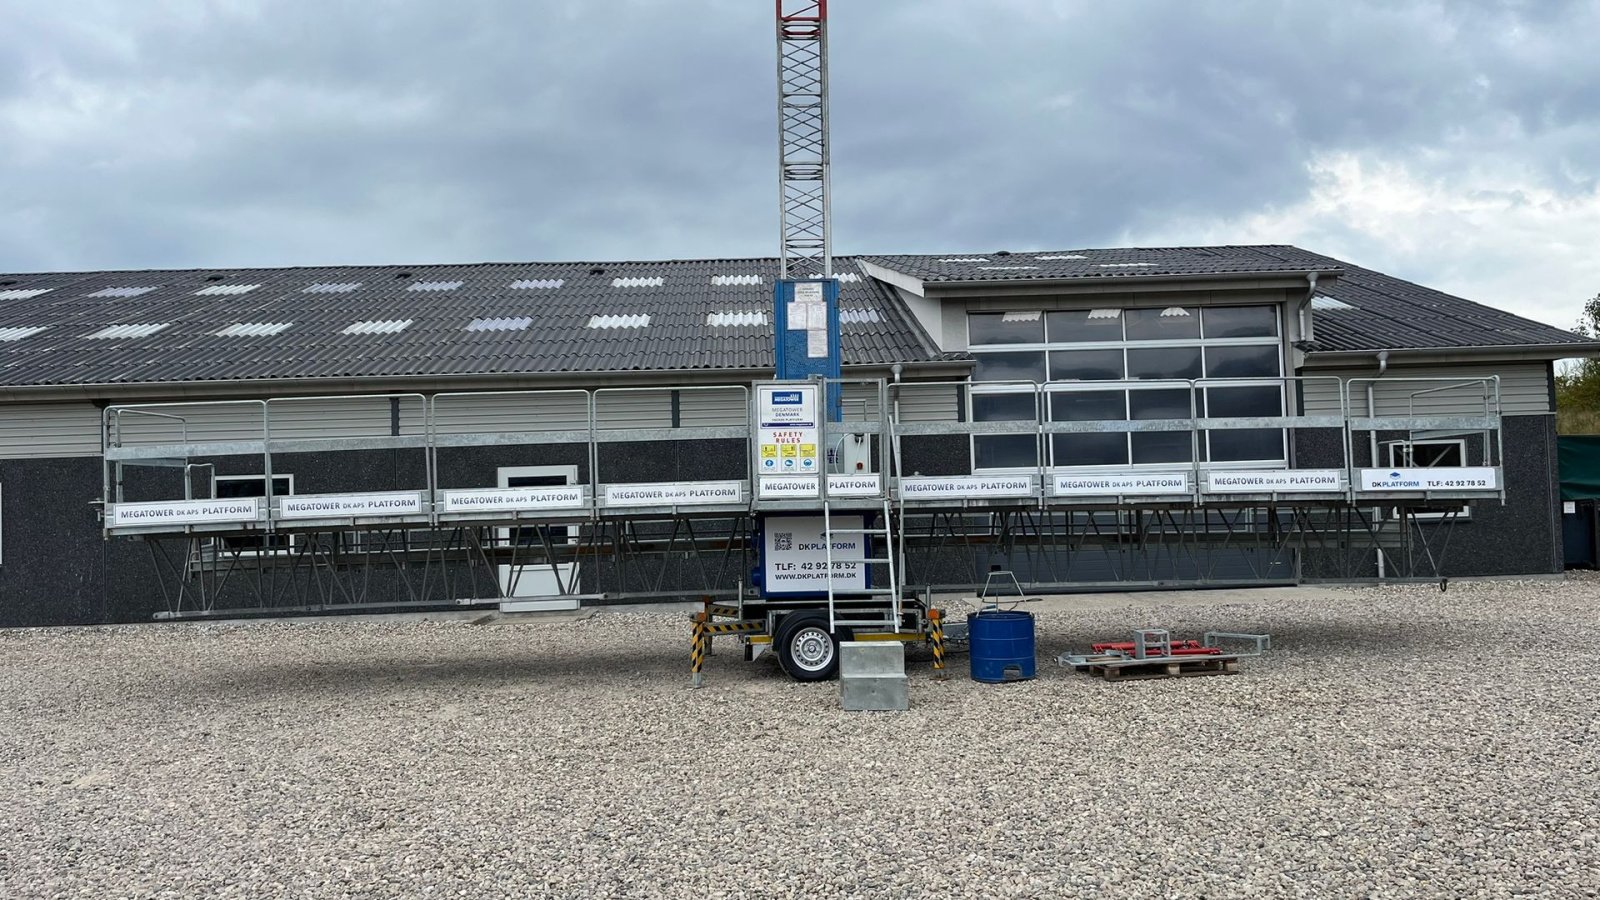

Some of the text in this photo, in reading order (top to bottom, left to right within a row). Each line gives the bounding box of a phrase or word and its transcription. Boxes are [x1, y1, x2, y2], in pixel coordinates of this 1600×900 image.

[1060, 480, 1110, 489] MEGATOWER
[1136, 479, 1182, 487] PLATFORM
[1215, 477, 1264, 485] MEGATOWER
[1290, 476, 1336, 484] PLATFORM
[765, 481, 876, 491] MEGATOWER PLATFORM
[904, 483, 955, 492] MEGATOWER
[980, 482, 1027, 490] PLATFORM
[451, 496, 503, 505] MEGATOWER
[530, 493, 578, 502] PLATFORM
[611, 490, 663, 499] MEGATOWER
[689, 489, 736, 497] PLATFORM
[287, 502, 340, 511] MEGATOWER
[368, 499, 416, 508] PLATFORM
[121, 509, 174, 519] MEGATOWER
[202, 506, 252, 515] PLATFORM
[798, 542, 856, 551] DKPLAFORM
[775, 562, 797, 571] TLF:
[801, 562, 813, 570] 42
[815, 562, 828, 570] 92
[844, 561, 856, 569] 52
